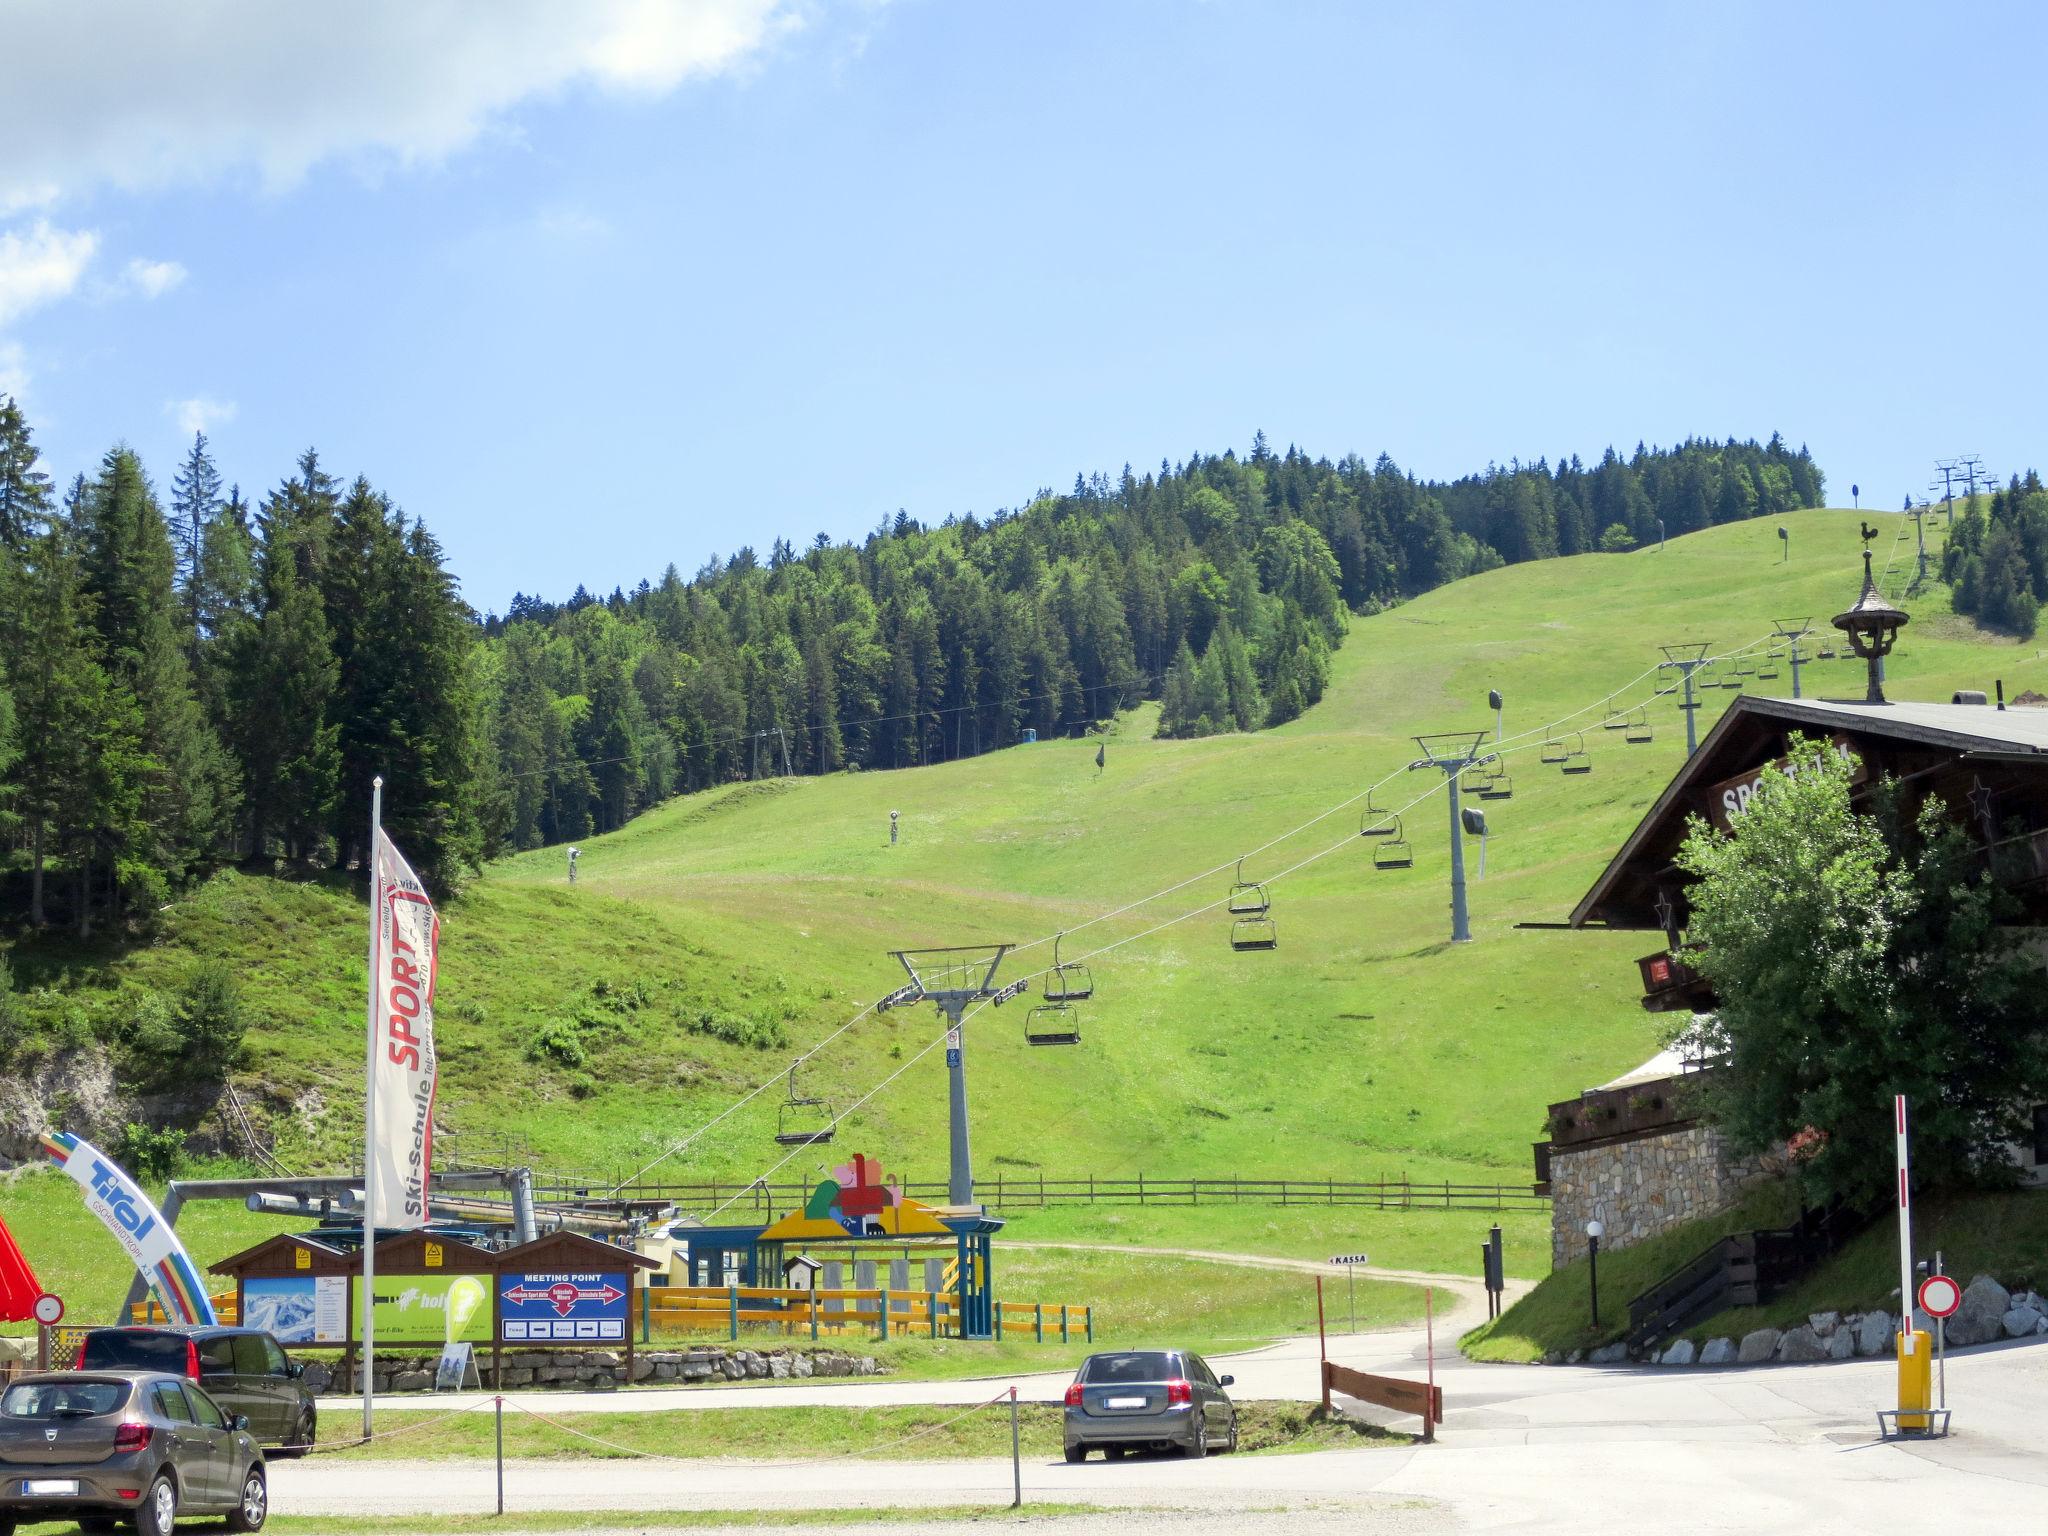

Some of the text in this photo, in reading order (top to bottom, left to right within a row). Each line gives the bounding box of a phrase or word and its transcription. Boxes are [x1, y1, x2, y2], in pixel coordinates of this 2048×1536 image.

[382, 906, 390, 940] Seefeld
[389, 935, 420, 1072] SPORT
[405, 1080, 431, 1217] Ski-Schule
[91, 1159, 156, 1242] Tirol
[92, 1200, 144, 1259] GSCHWANDTKOPF
[524, 1274, 602, 1282] MEETING POINT
[1335, 1255, 1366, 1265] KASSA
